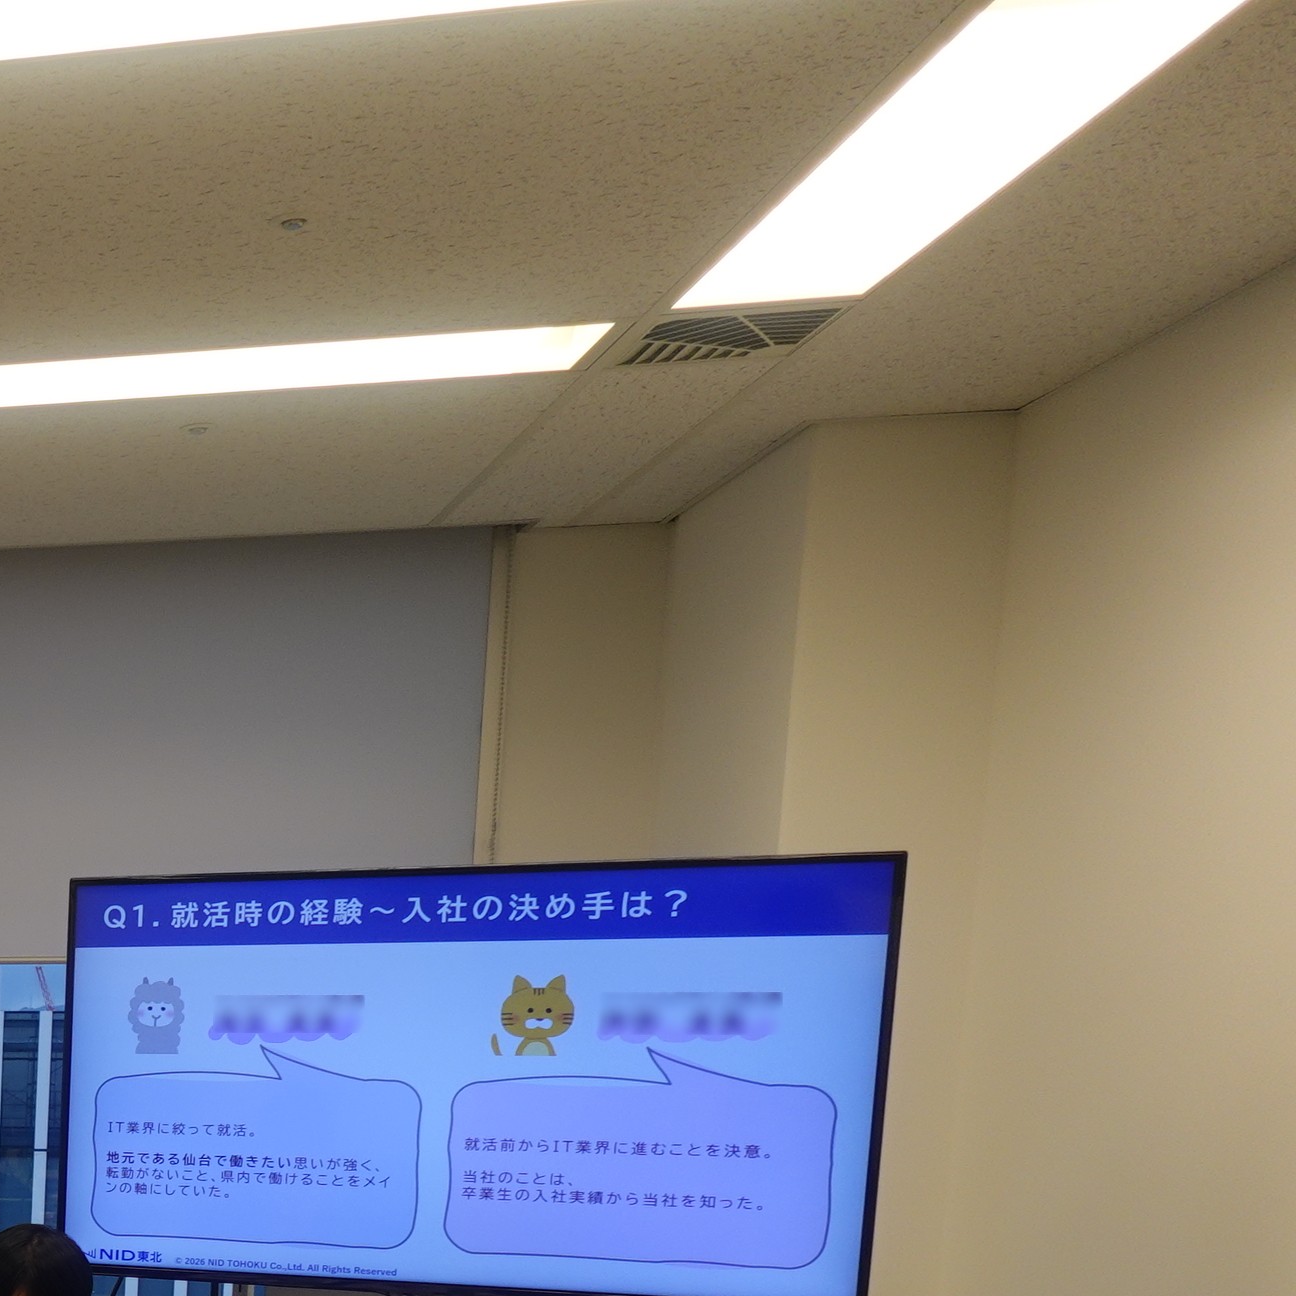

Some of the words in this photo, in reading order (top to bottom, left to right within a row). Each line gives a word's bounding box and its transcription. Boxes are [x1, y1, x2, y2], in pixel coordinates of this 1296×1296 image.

[103, 903, 161, 930] Q1.
[107, 1121, 257, 1138] IT業界に絞って就活。
[464, 1137, 772, 1160] 就活前からIT業界に進むことを決意。
[106, 1151, 383, 1173] 地元である仙台で働きたい思いが強く、
[106, 1166, 392, 1190] 転勤がないこと、県内で働けることをメイ
[462, 1170, 574, 1187] 当社のことは、
[106, 1181, 232, 1199] ンの軸にしていた。
[461, 1186, 765, 1212] 卒業生の入社実績から当社を知った。
[184, 1257, 206, 1266] 2026
[208, 1258, 225, 1267] NID
[227, 1259, 268, 1270] TOHOKU
[307, 1262, 320, 1272] All
[322, 1264, 352, 1276] Rights
[353, 1265, 397, 1277] Reserved
